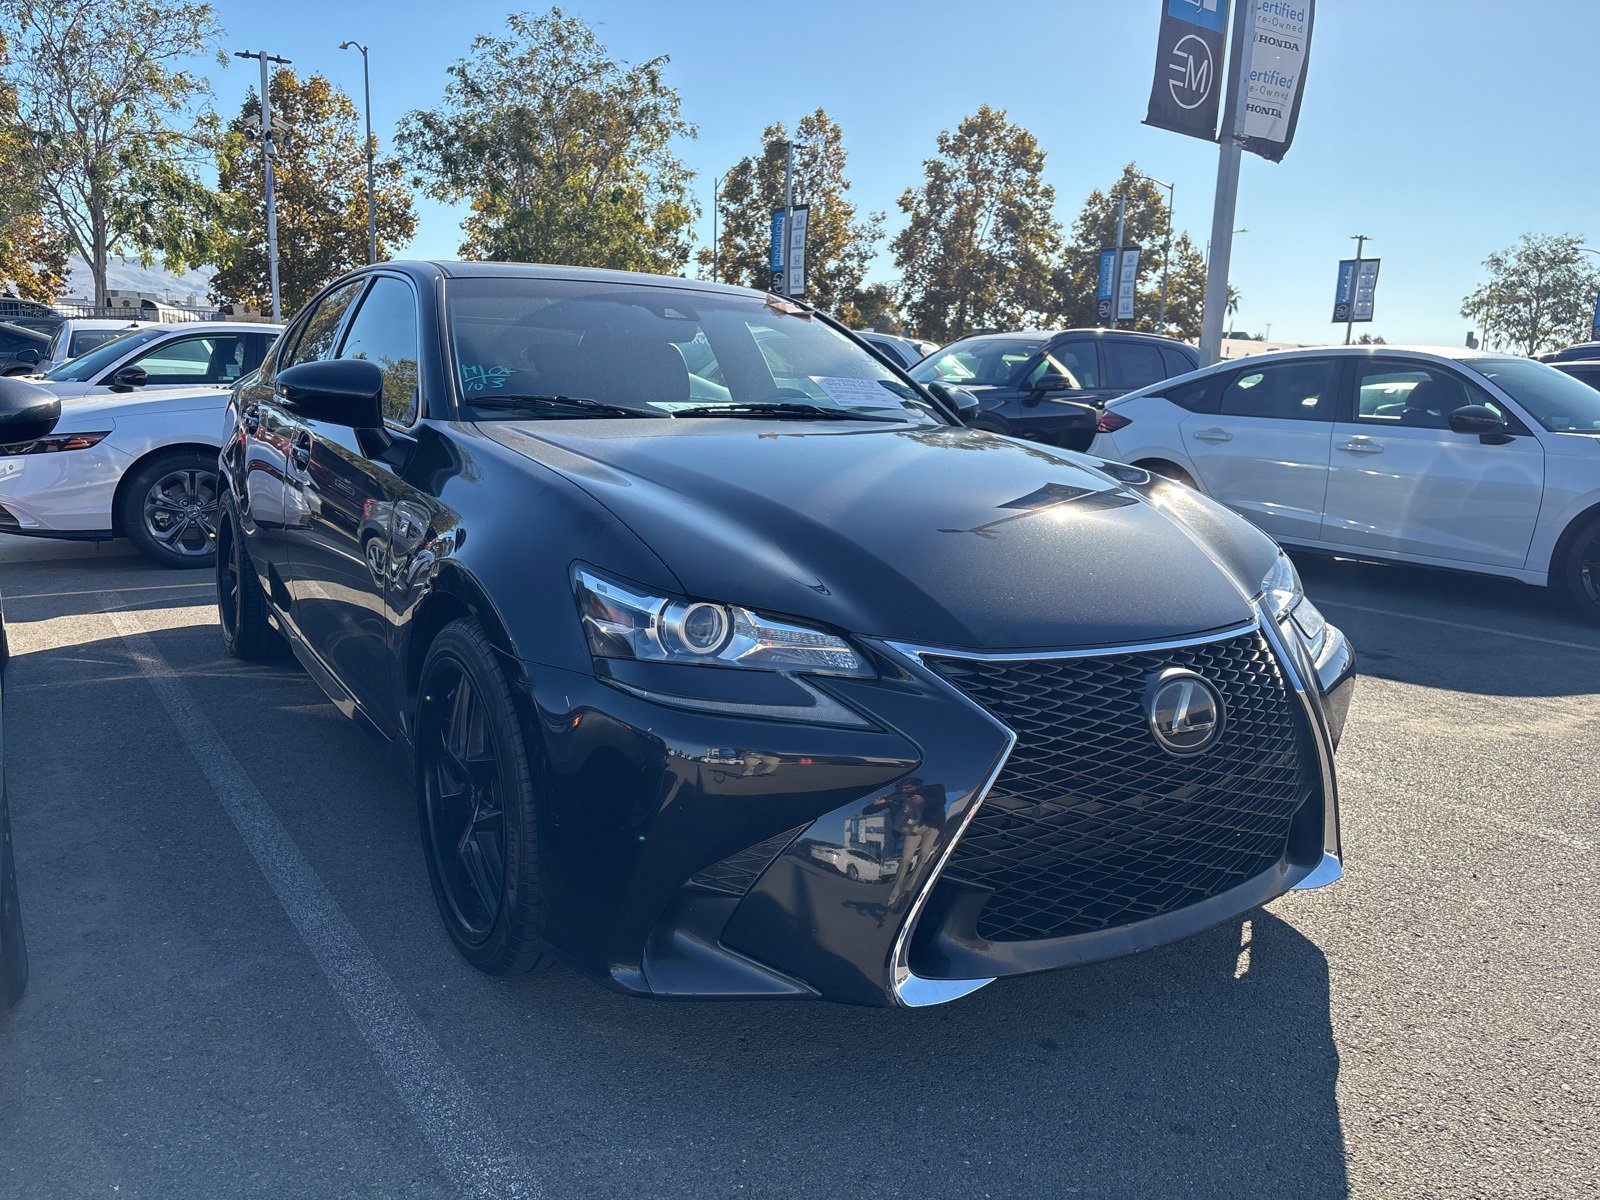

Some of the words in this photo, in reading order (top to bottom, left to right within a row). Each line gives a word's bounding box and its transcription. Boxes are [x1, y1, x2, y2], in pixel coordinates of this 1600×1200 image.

[1257, 15, 1303, 33] re-Owned
[1259, 34, 1300, 52] HONDA
[1249, 70, 1295, 89] ertified
[1248, 85, 1289, 100] e-Owned
[1246, 103, 1282, 119] HONDA
